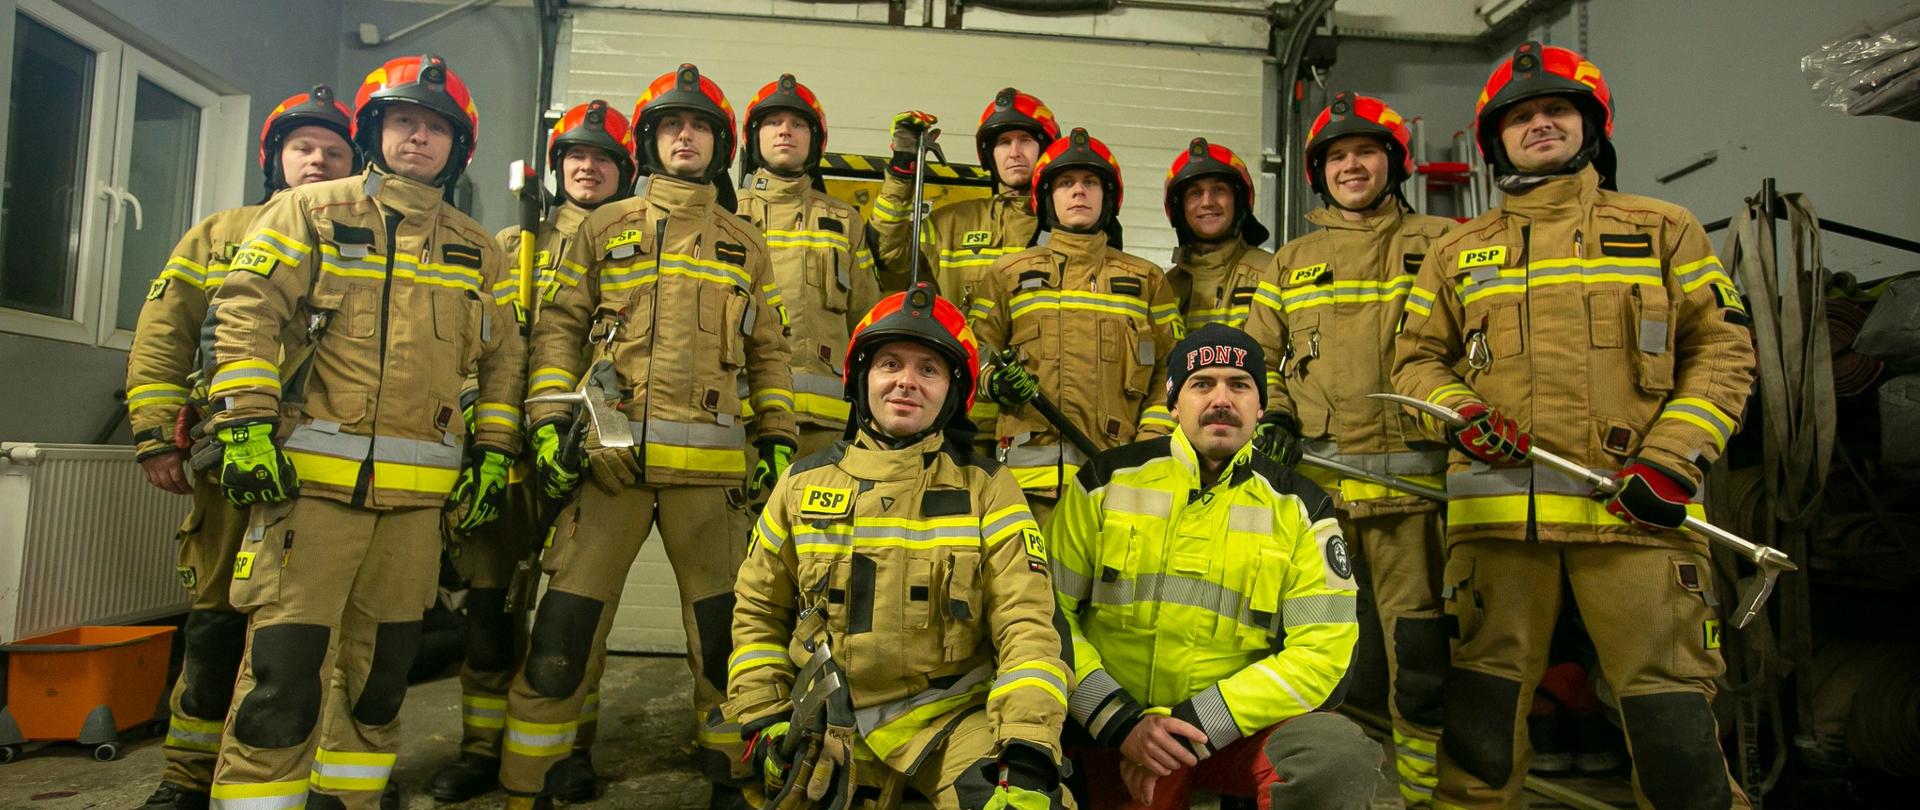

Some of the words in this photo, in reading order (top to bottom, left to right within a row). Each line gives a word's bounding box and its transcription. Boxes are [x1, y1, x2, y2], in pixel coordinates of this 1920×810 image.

[967, 233, 988, 243] PSP
[234, 253, 268, 267] PSP
[1466, 250, 1499, 263] PSP
[1295, 267, 1321, 281] PSP
[1187, 345, 1248, 370] FDNY
[809, 490, 845, 508] PSP
[1029, 533, 1044, 554] PS
